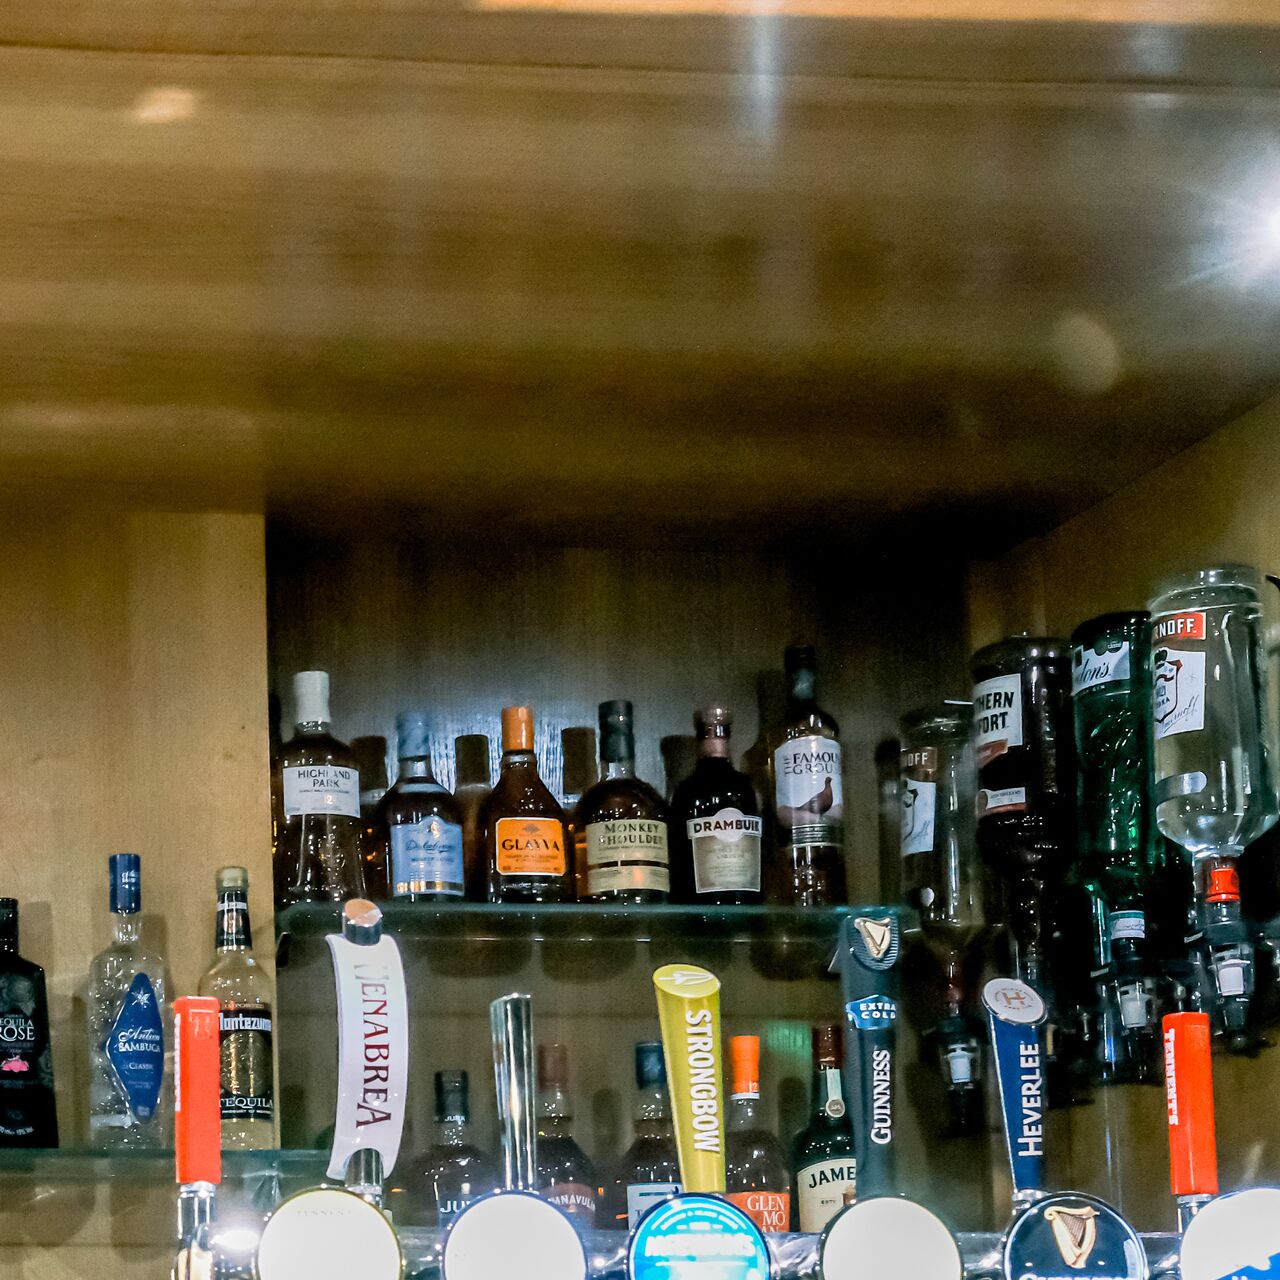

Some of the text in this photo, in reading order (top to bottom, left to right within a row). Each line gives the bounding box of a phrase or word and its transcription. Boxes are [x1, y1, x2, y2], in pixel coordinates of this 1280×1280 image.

[313, 779, 339, 788] PARK
[605, 823, 658, 834] MONKEY
[502, 839, 559, 851] GLAYVA
[860, 1003, 896, 1011] EXTRA
[861, 1011, 895, 1019] COLD
[685, 1010, 720, 1154] STRONGBOW
[871, 1050, 891, 1144] GUINNESS
[1018, 1043, 1043, 1157] HEVERLEE
[747, 1196, 785, 1210] GLEN
